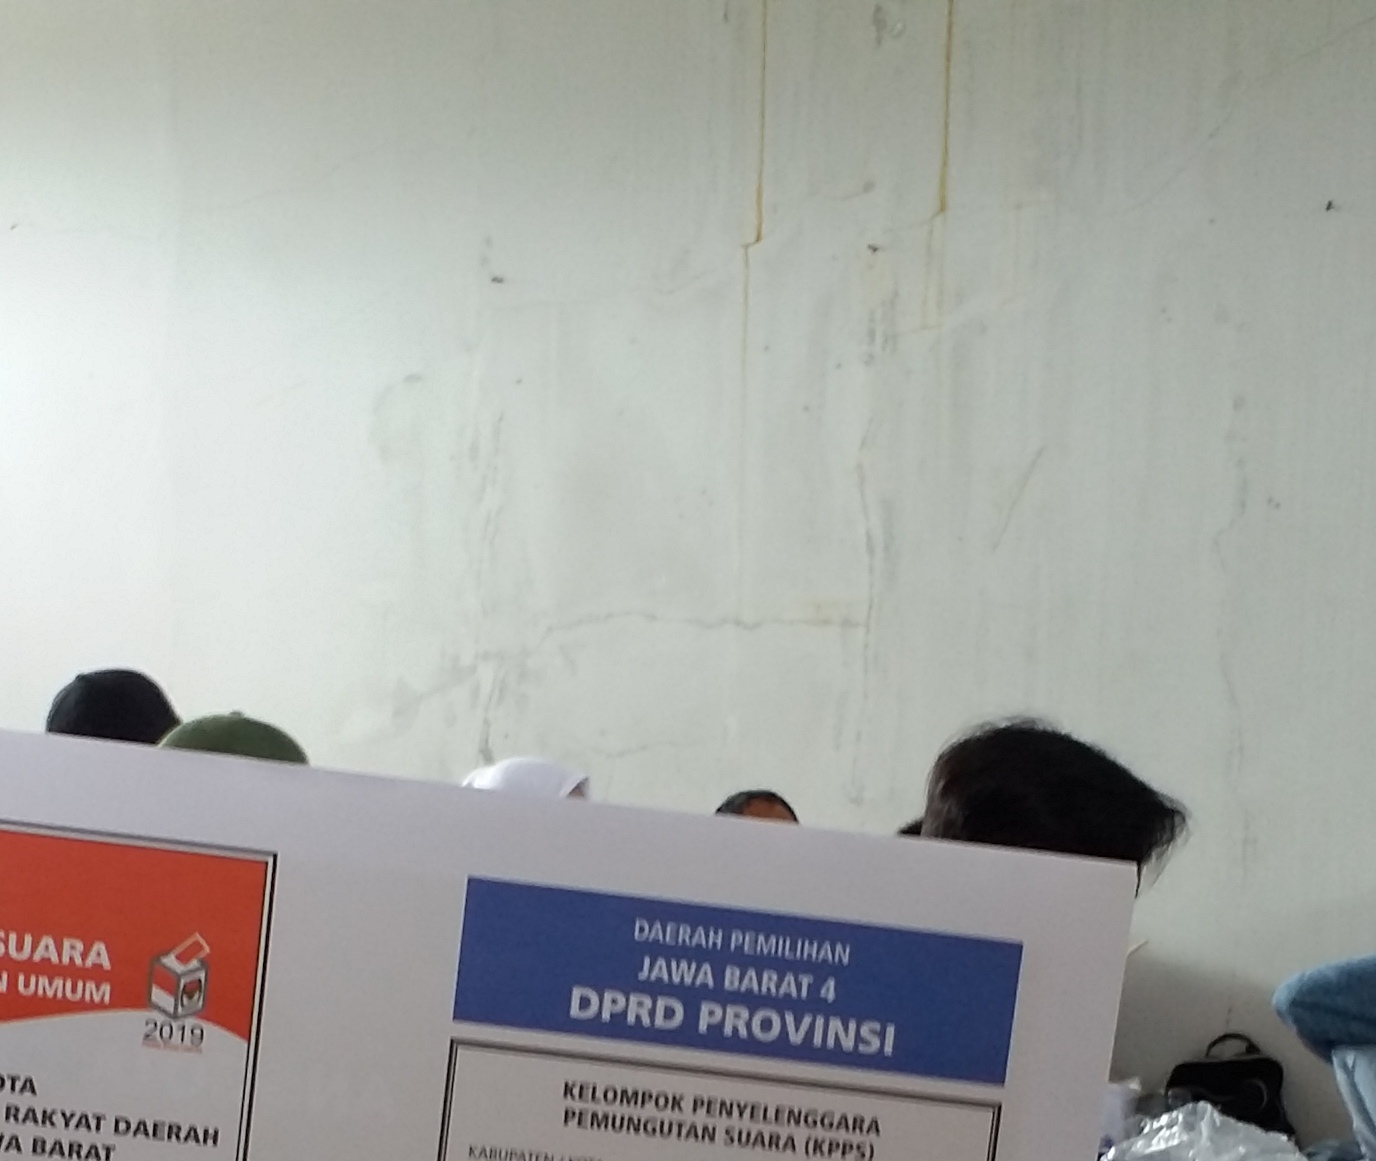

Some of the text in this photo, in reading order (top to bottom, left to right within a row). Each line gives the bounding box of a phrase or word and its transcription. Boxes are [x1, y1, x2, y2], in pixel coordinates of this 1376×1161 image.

[633, 917, 851, 967] DAERAH PEMILIHAN
[17, 971, 112, 1005] UMUM
[637, 955, 836, 1004] JAWA BARAT 4
[144, 1017, 206, 1047] 2019
[569, 985, 896, 1058] DPRD PROVINSI
[3, 1103, 107, 1134] RAKYAT
[113, 1115, 221, 1148] DAERAH
[562, 1107, 717, 1145] PEMUNGUTAN
[723, 1127, 797, 1154] SUARA
[563, 1080, 882, 1138] KELOMPOK PENYELENGGARA
